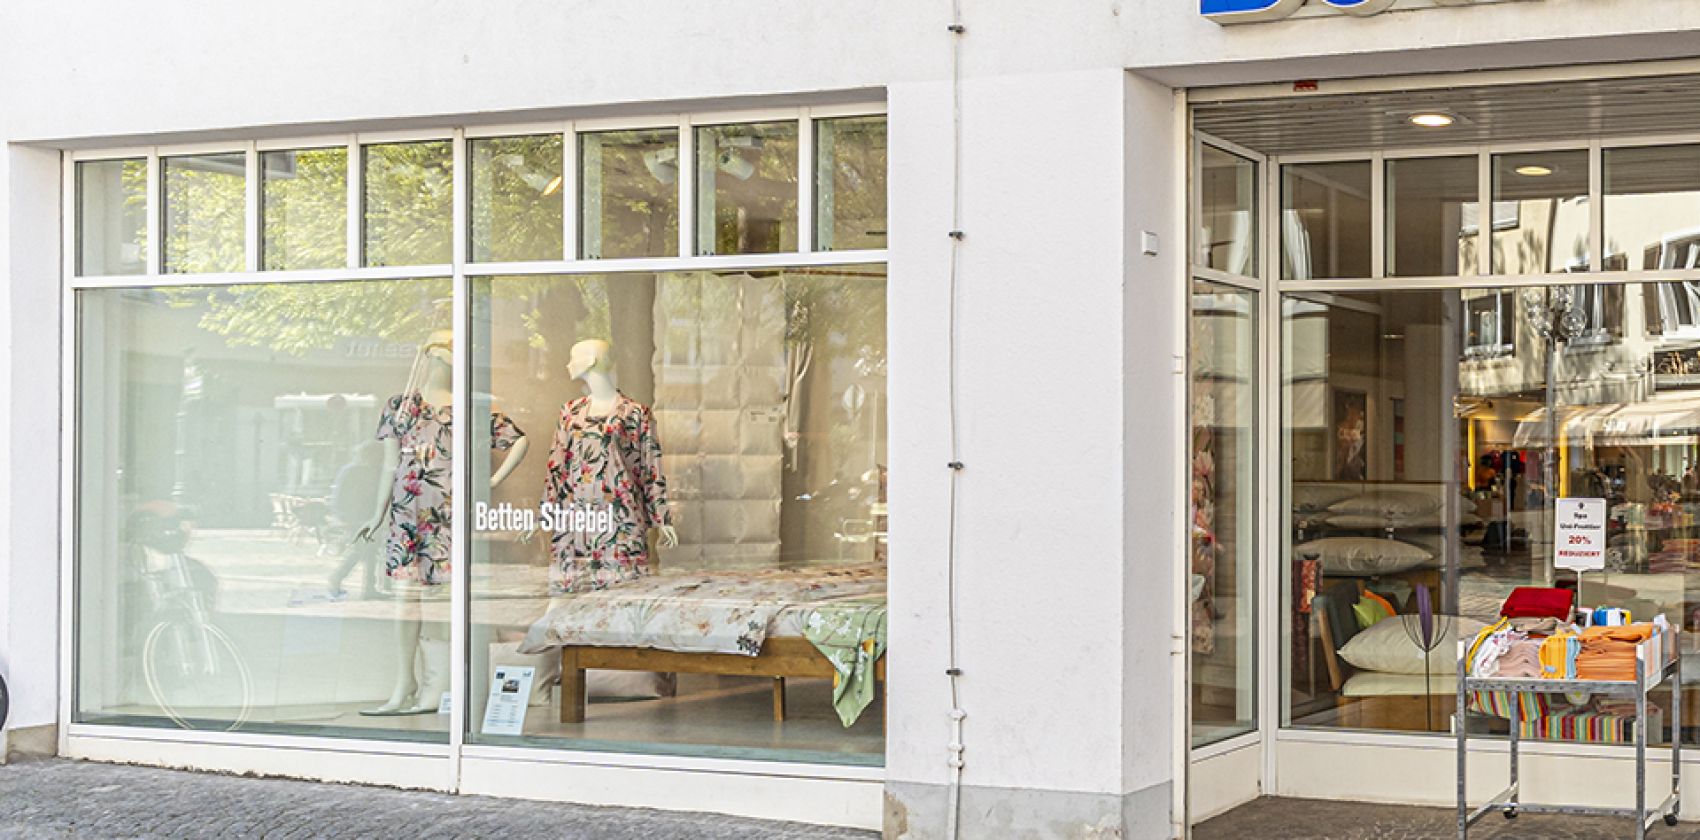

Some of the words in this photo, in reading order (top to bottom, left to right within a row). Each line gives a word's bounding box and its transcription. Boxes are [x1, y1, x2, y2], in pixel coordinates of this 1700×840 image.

[475, 502, 534, 531] Betten
[541, 502, 614, 533] Striebel
[1568, 535, 1592, 544] 20%
